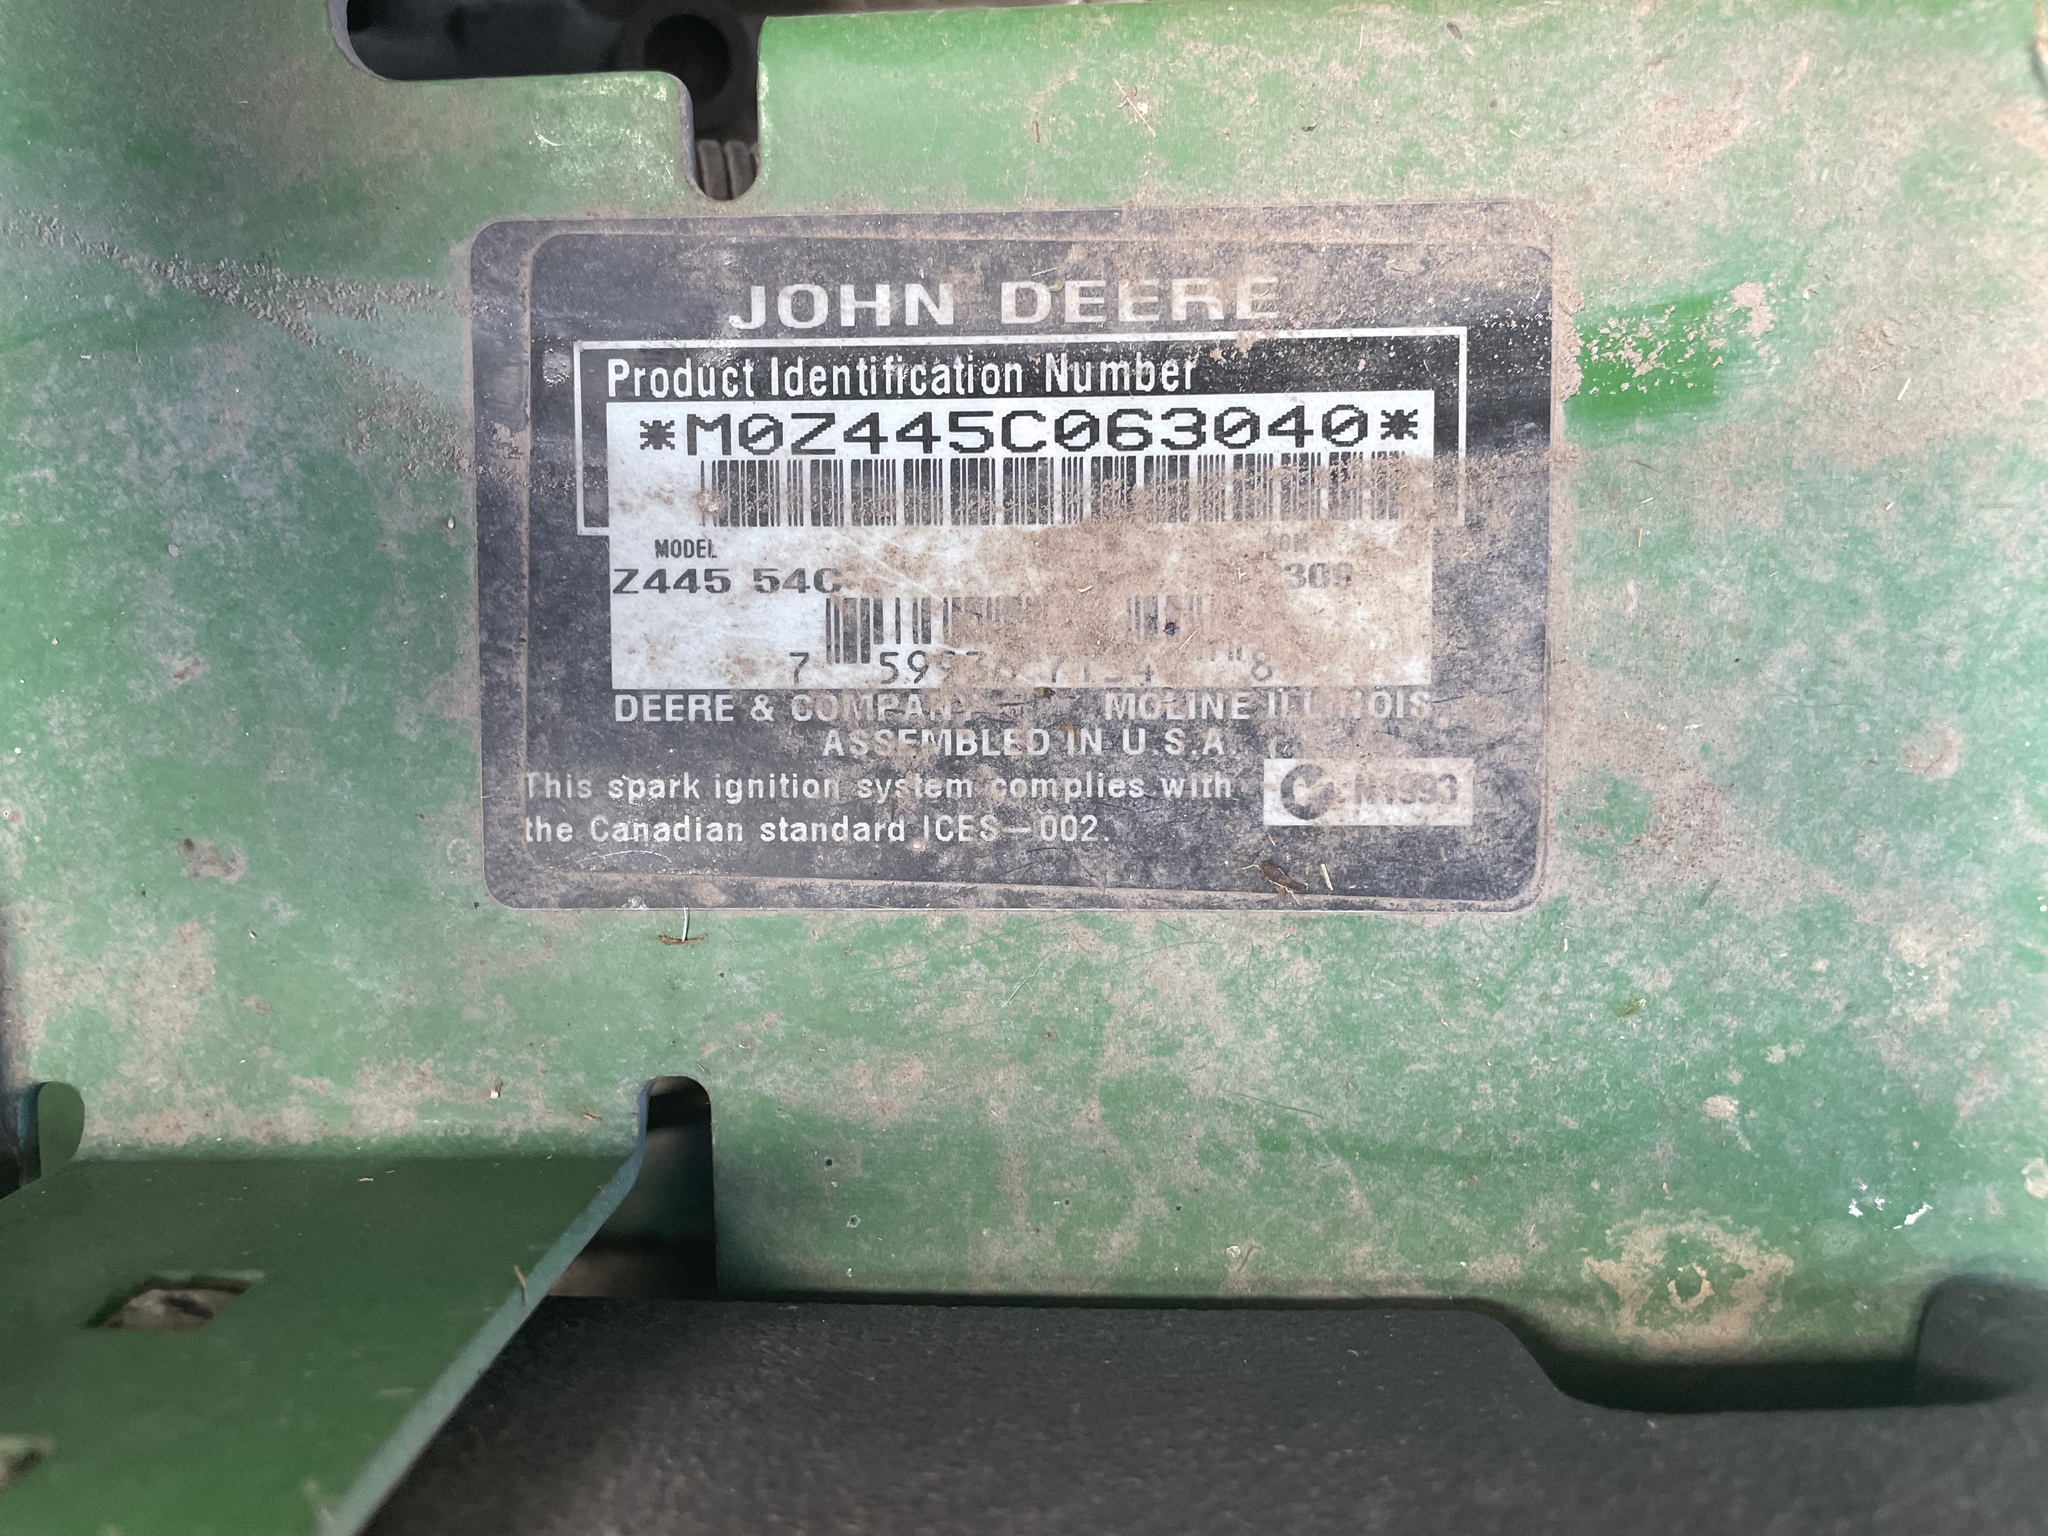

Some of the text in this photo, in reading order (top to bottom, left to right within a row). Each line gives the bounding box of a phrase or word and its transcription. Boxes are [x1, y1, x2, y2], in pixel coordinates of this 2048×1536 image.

[728, 277, 1279, 330] JOHN DEERE
[607, 351, 1196, 398] Product Identification Number
[654, 538, 718, 559] MODEL
[612, 567, 732, 595] Z445
[788, 651, 810, 685] 7
[614, 694, 735, 723] DEERE
[750, 693, 774, 723] &
[1104, 691, 1251, 721] MOLINE
[822, 728, 1050, 758] ASSEMBLED
[1067, 728, 1102, 755] IN
[526, 770, 1232, 805] This spark ignition system complies with
[525, 815, 574, 843] the
[589, 814, 744, 843] Canadian
[760, 814, 906, 843] standard
